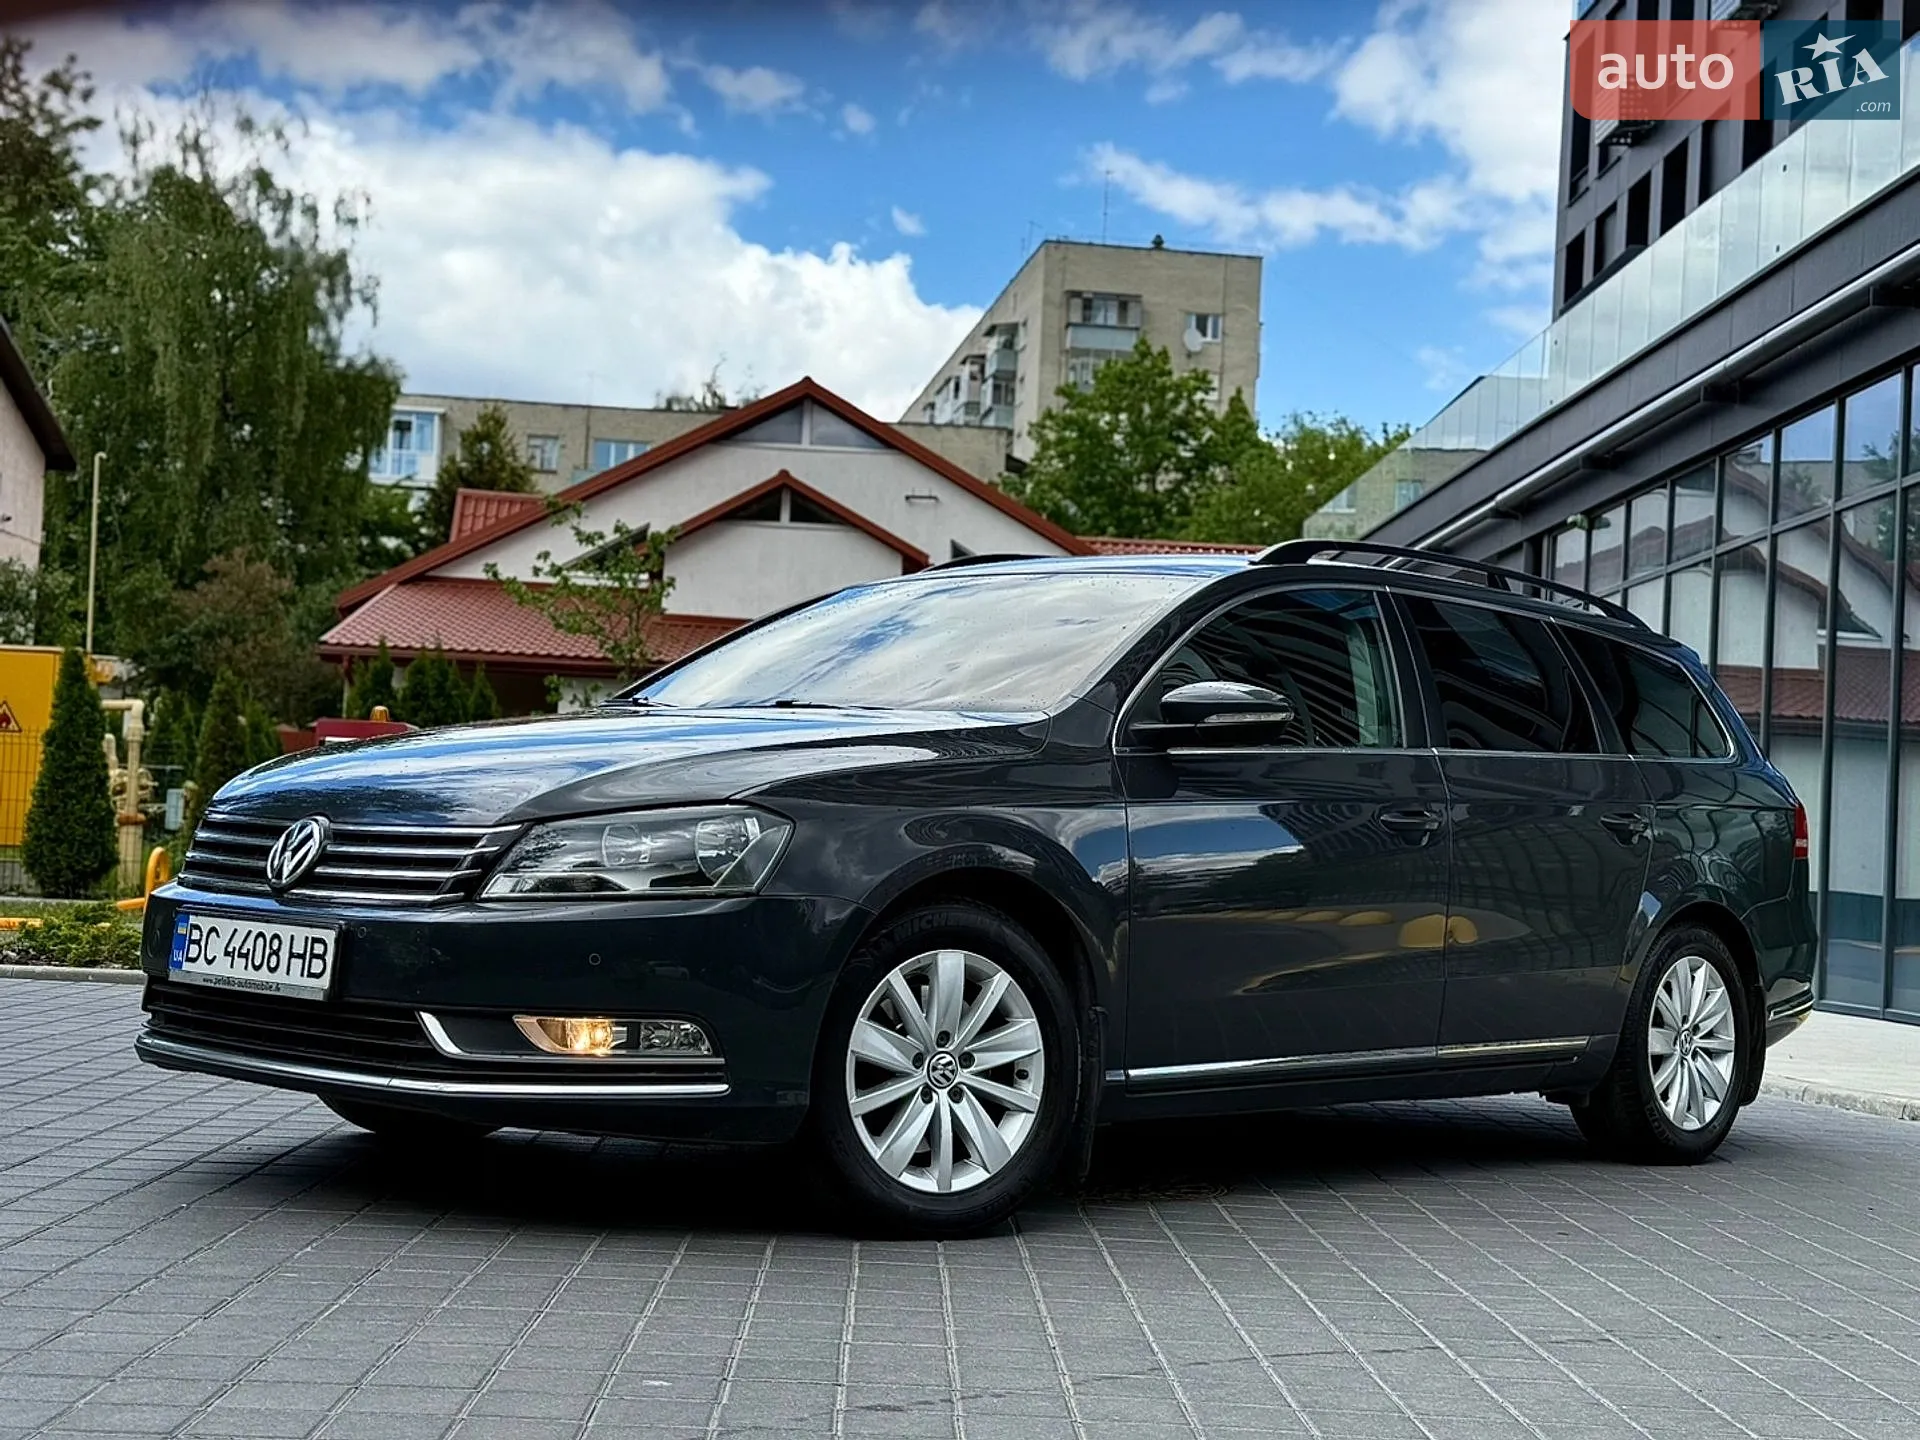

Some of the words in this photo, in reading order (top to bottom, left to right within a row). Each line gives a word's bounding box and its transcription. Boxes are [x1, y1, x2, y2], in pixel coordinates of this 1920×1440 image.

[184, 923, 220, 966] BC
[223, 927, 283, 974] 4408
[286, 934, 328, 979] HB
